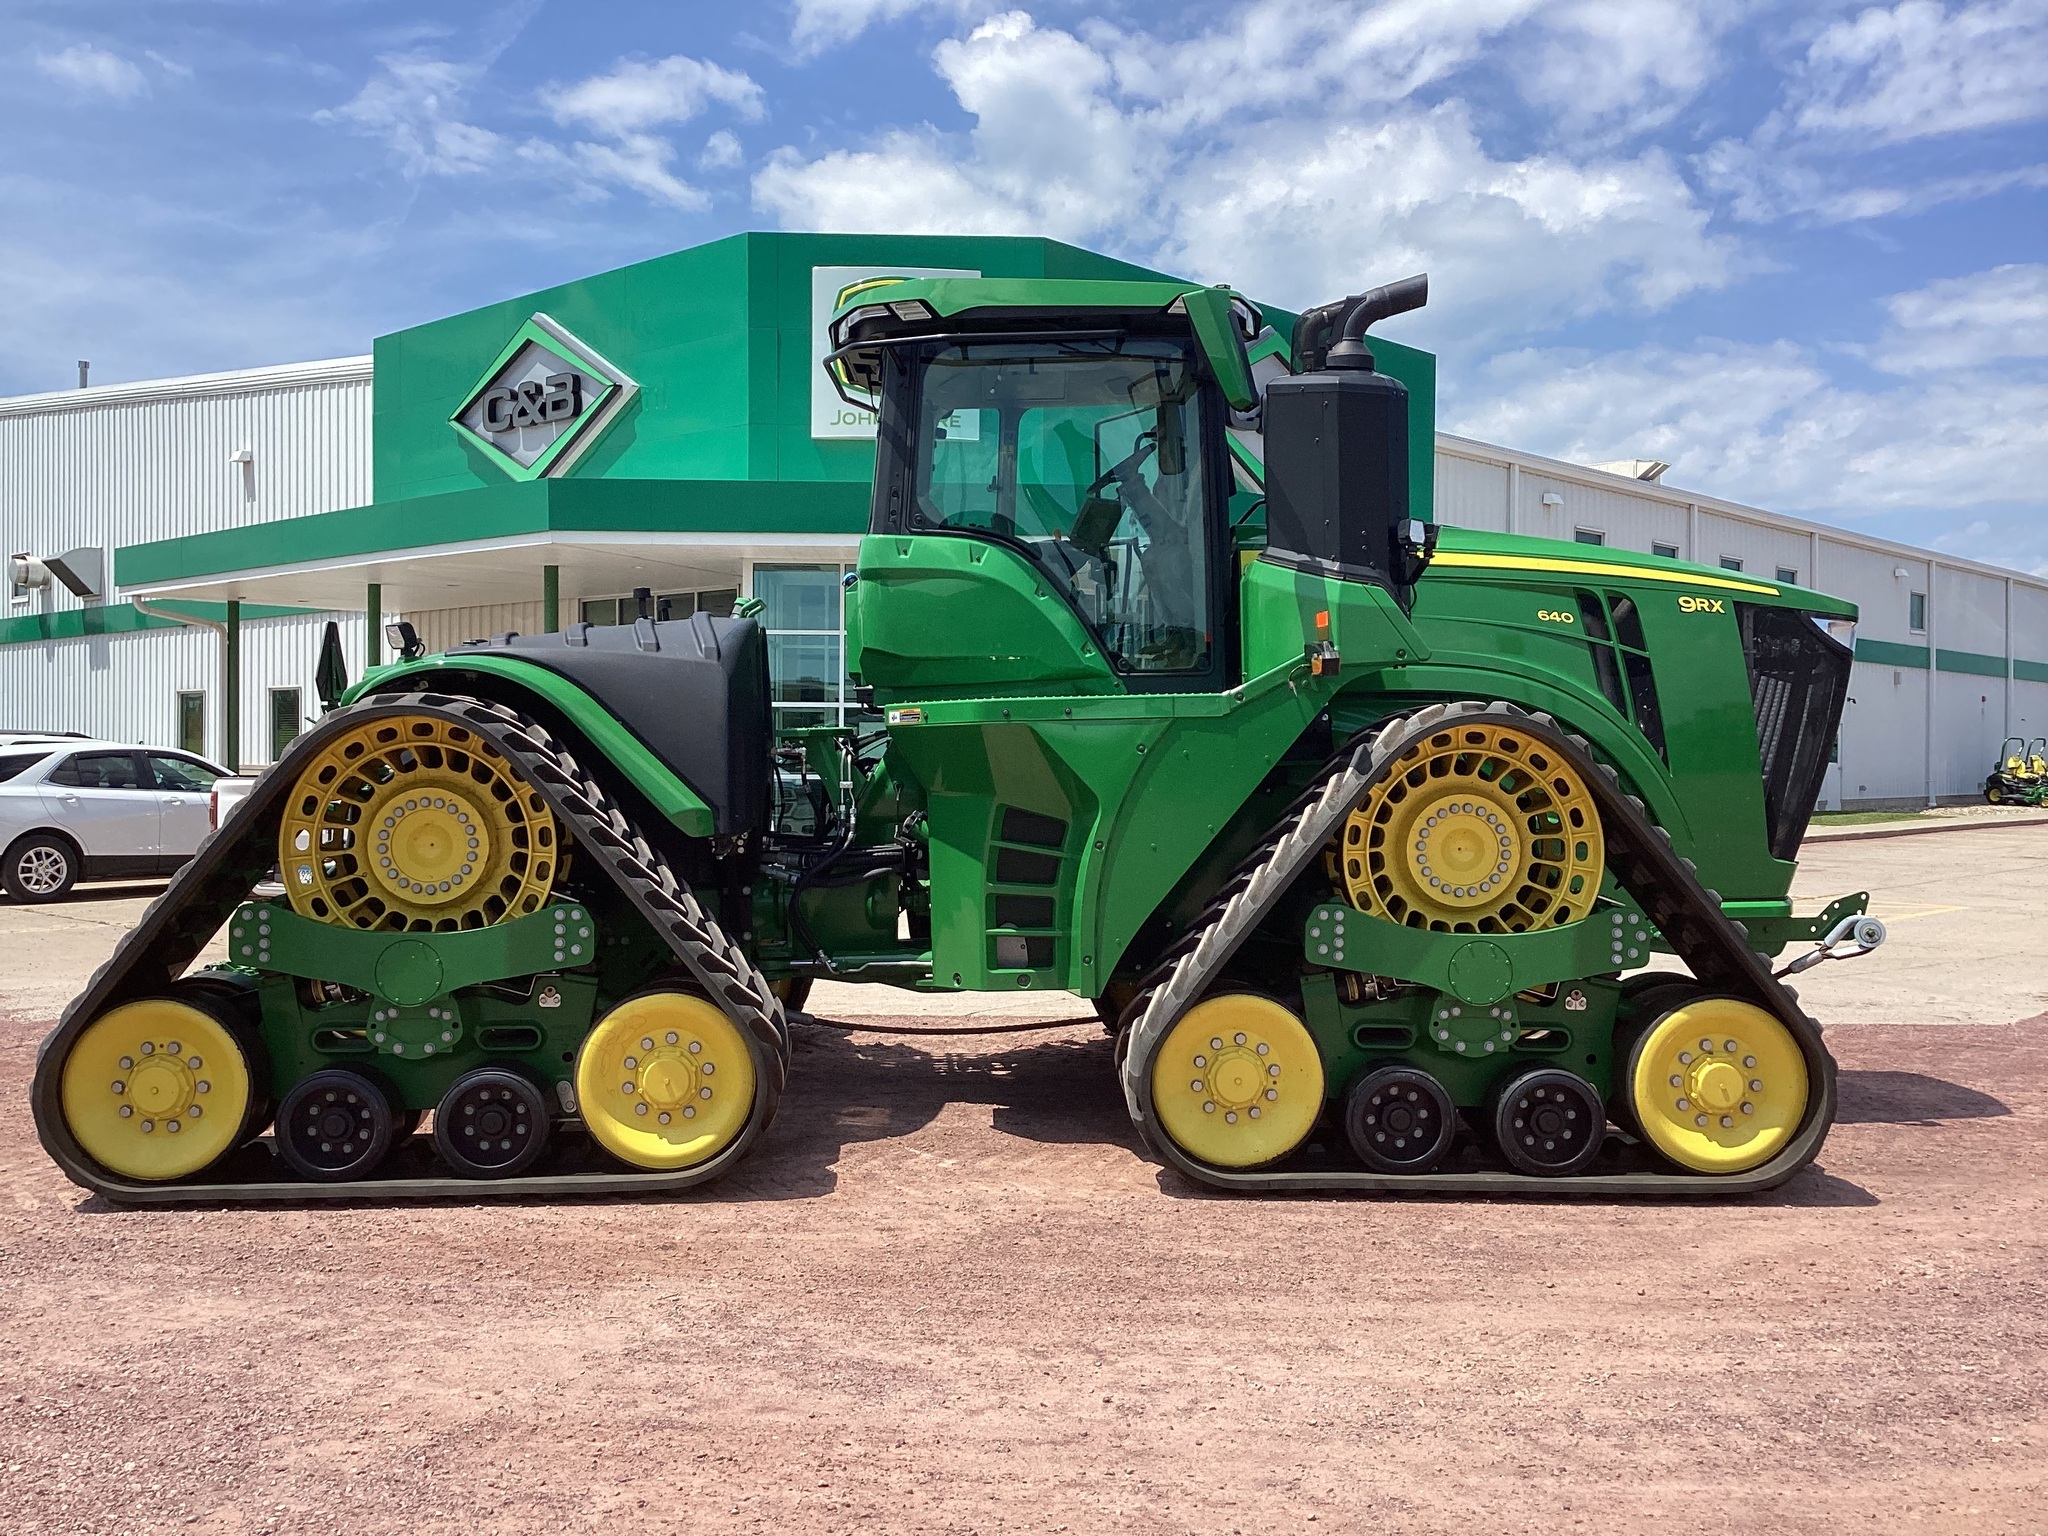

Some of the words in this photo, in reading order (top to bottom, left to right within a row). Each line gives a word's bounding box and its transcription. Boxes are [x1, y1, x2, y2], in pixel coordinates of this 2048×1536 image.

[483, 372, 582, 433] C&B
[1678, 596, 1726, 614] 9RX
[1537, 610, 1575, 624] 640
